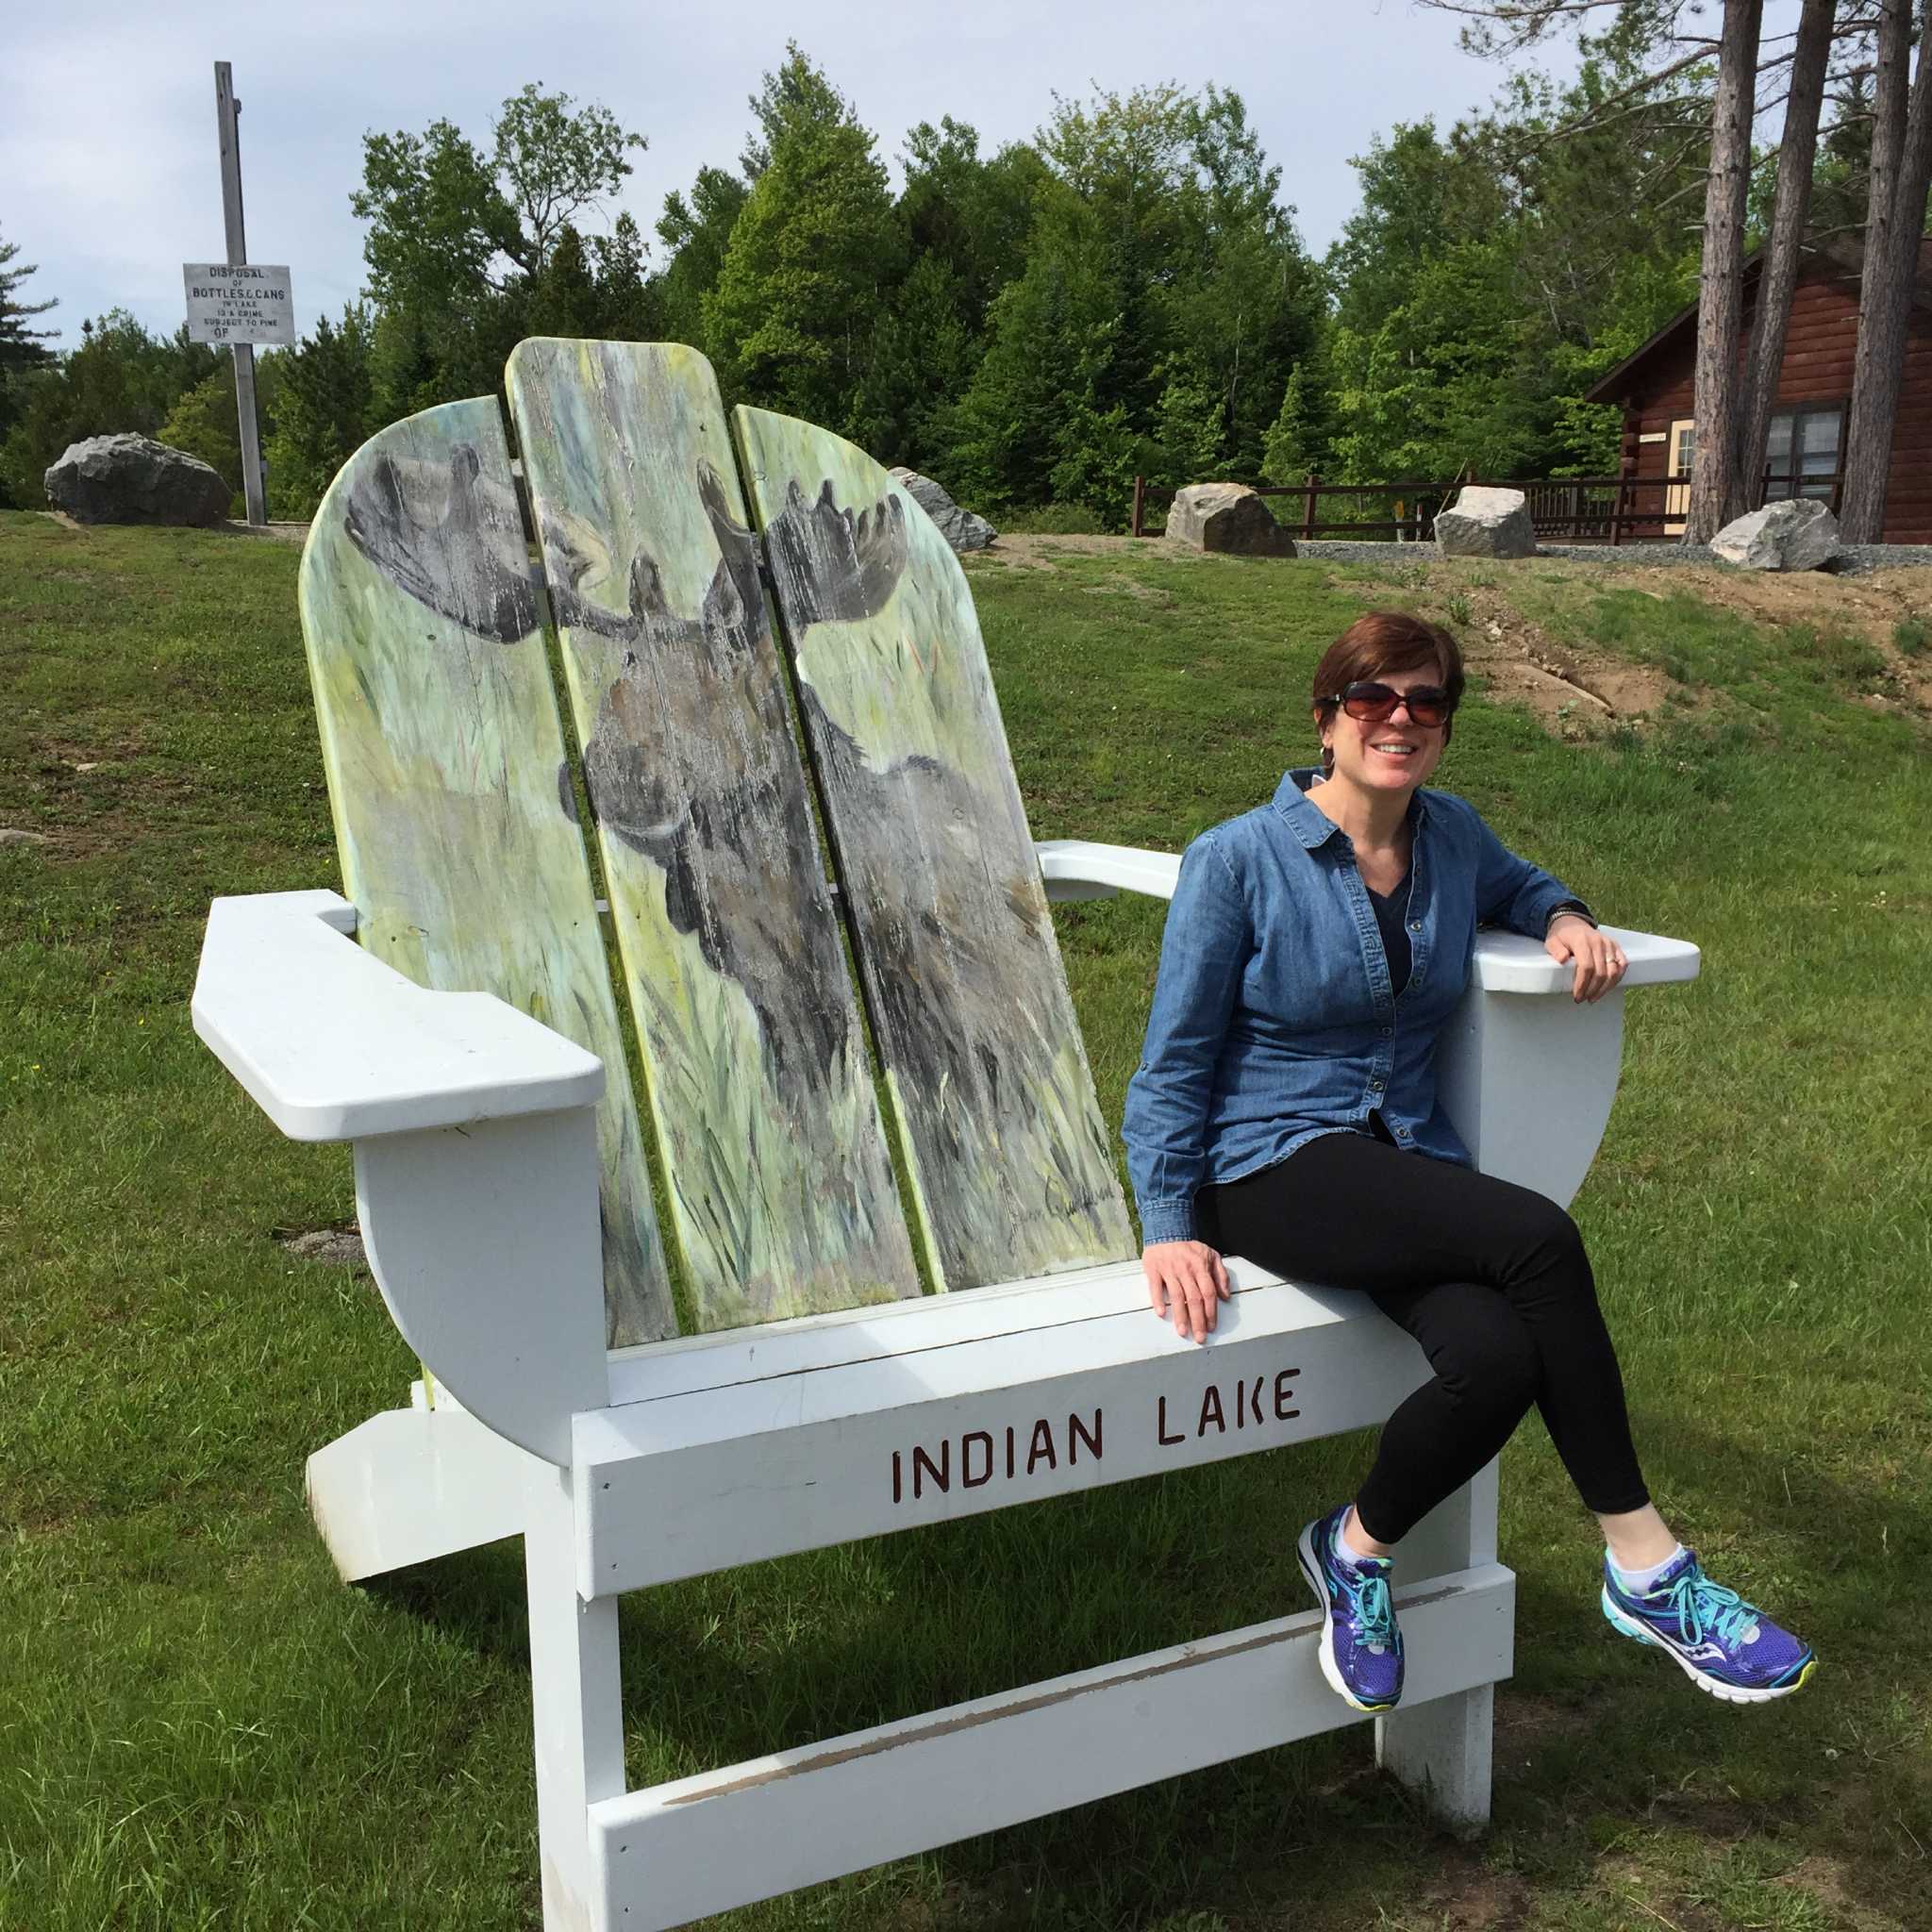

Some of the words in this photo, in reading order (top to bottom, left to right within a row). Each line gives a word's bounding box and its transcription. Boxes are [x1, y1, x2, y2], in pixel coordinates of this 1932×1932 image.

[238, 309, 264, 318] CRIME
[204, 318, 242, 326] SUBJECT
[213, 327, 228, 339] OF
[891, 1407, 1103, 1504] INDIAN
[1158, 1368, 1301, 1446] LAKE
